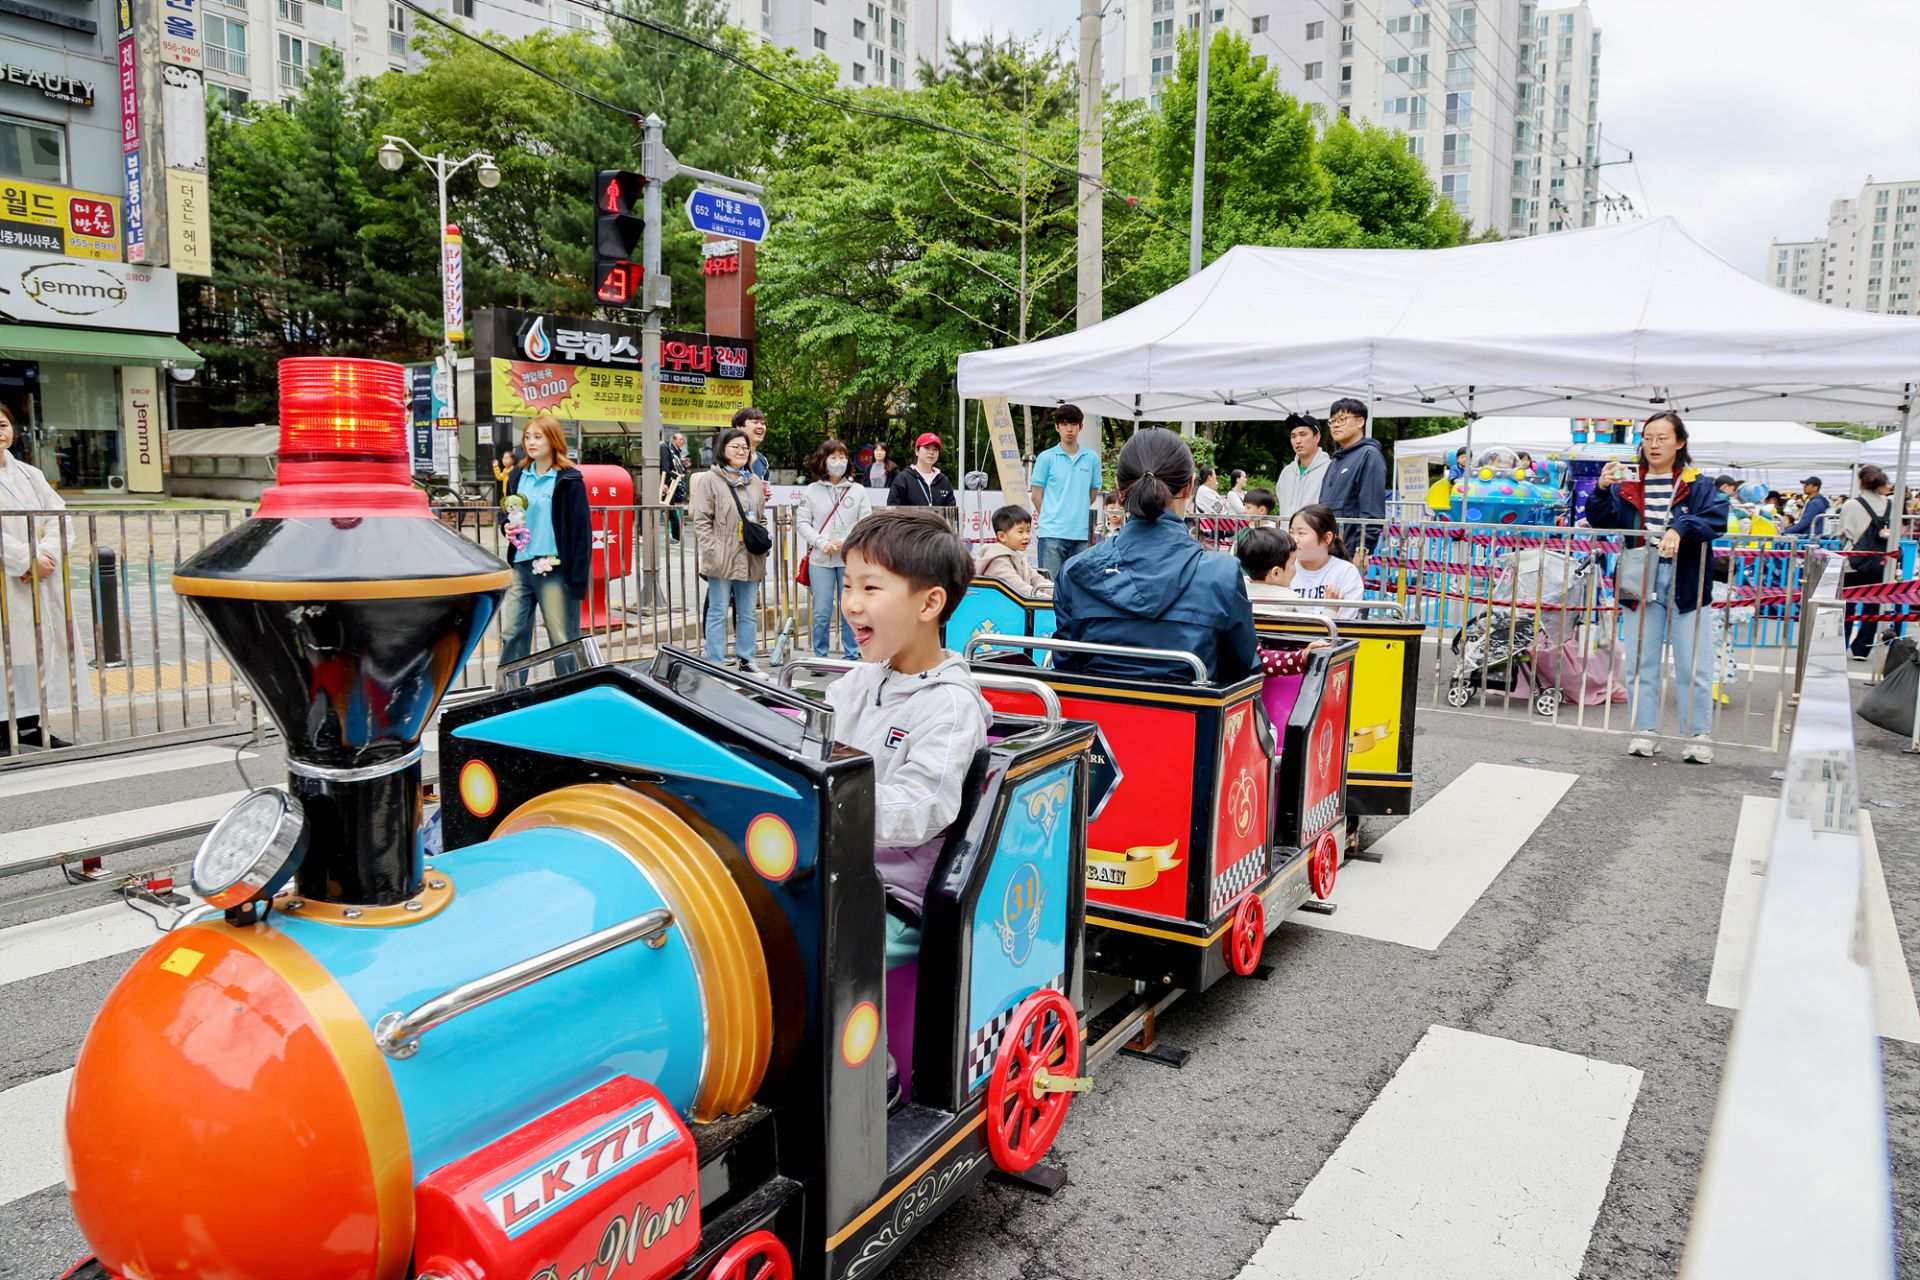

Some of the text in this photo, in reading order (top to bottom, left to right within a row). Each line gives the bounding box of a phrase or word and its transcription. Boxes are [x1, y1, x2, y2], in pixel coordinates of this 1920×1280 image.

[127, 154, 141, 228] 부동산
[2, 187, 57, 218] 월드
[694, 204, 709, 216] 652
[715, 199, 743, 214] 마들로
[75, 216, 110, 234] 반찬
[747, 216, 761, 228] 648
[125, 272, 152, 282] SHOP
[32, 277, 126, 300] jemma
[555, 328, 639, 364] 루하스
[716, 346, 747, 368] 24시
[590, 373, 611, 388] 평일
[613, 374, 634, 390] 목욕
[132, 400, 151, 466] jemma
[1088, 753, 1105, 765] RK
[1086, 864, 1127, 885] RAIN
[1010, 877, 1034, 920] 31
[598, 1189, 696, 1280] Won
